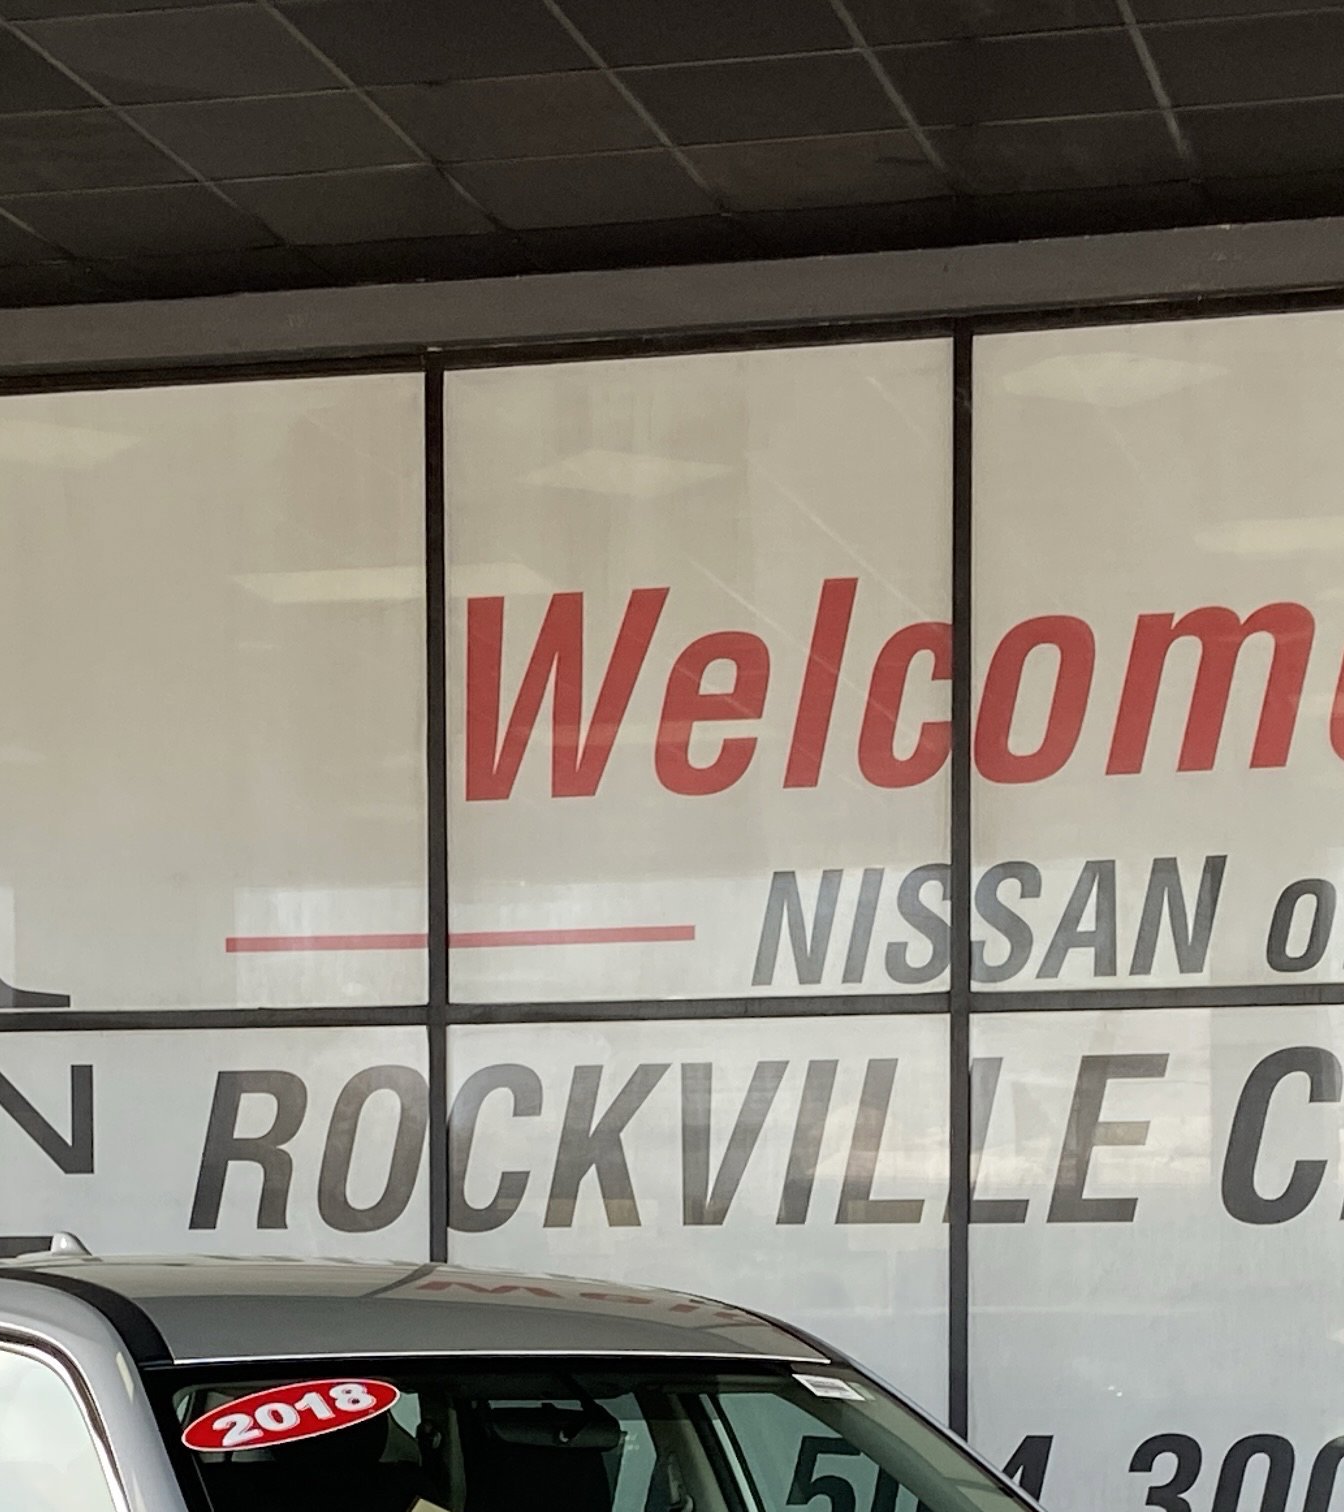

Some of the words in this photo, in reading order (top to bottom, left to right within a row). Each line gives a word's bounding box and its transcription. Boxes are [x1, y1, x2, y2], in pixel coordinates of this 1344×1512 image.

[753, 857, 1224, 986] NISSAN
[190, 1056, 1169, 1230] ROCKVILLE
[212, 1383, 376, 1447] 2018
